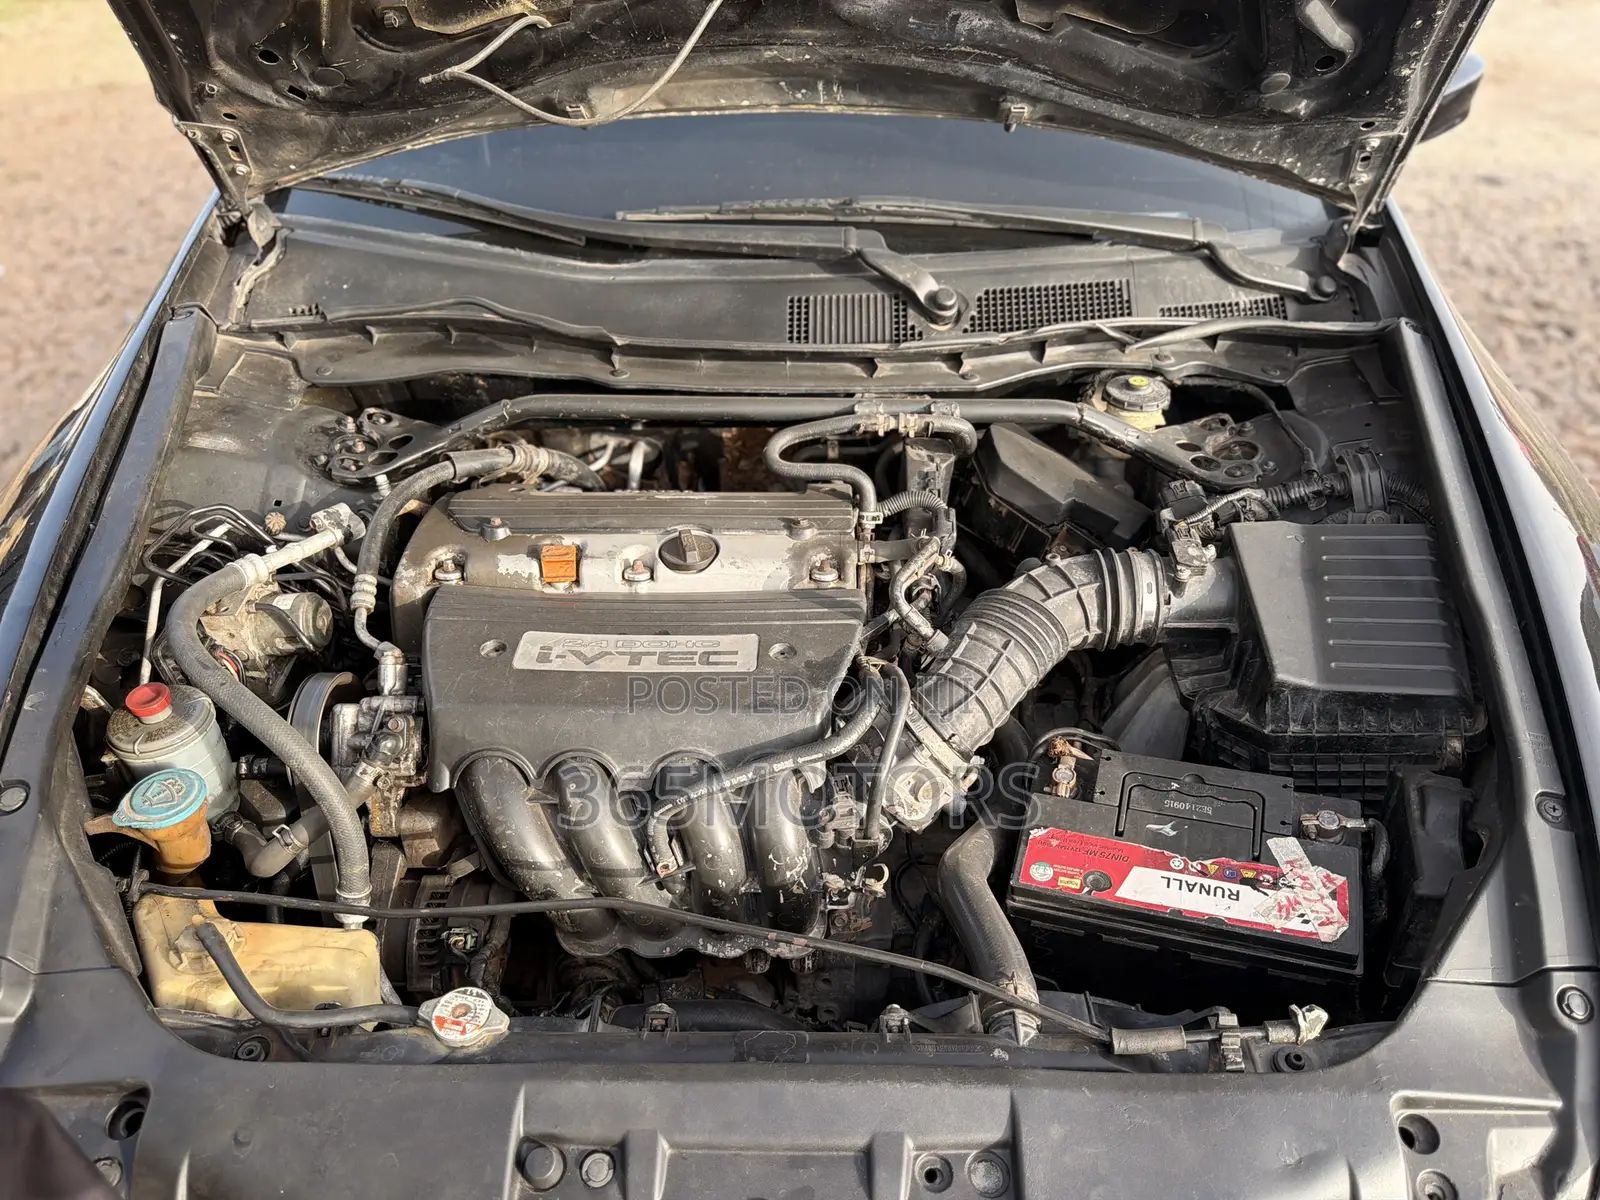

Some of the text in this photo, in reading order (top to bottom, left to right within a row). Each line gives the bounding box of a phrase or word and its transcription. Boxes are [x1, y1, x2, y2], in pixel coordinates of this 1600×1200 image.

[615, 639, 720, 649] DOHC
[535, 645, 739, 667] i-VTEC
[1082, 848, 1099, 858] MF
[1099, 851, 1130, 863] DIN75
[1159, 875, 1241, 903] RUNALL
